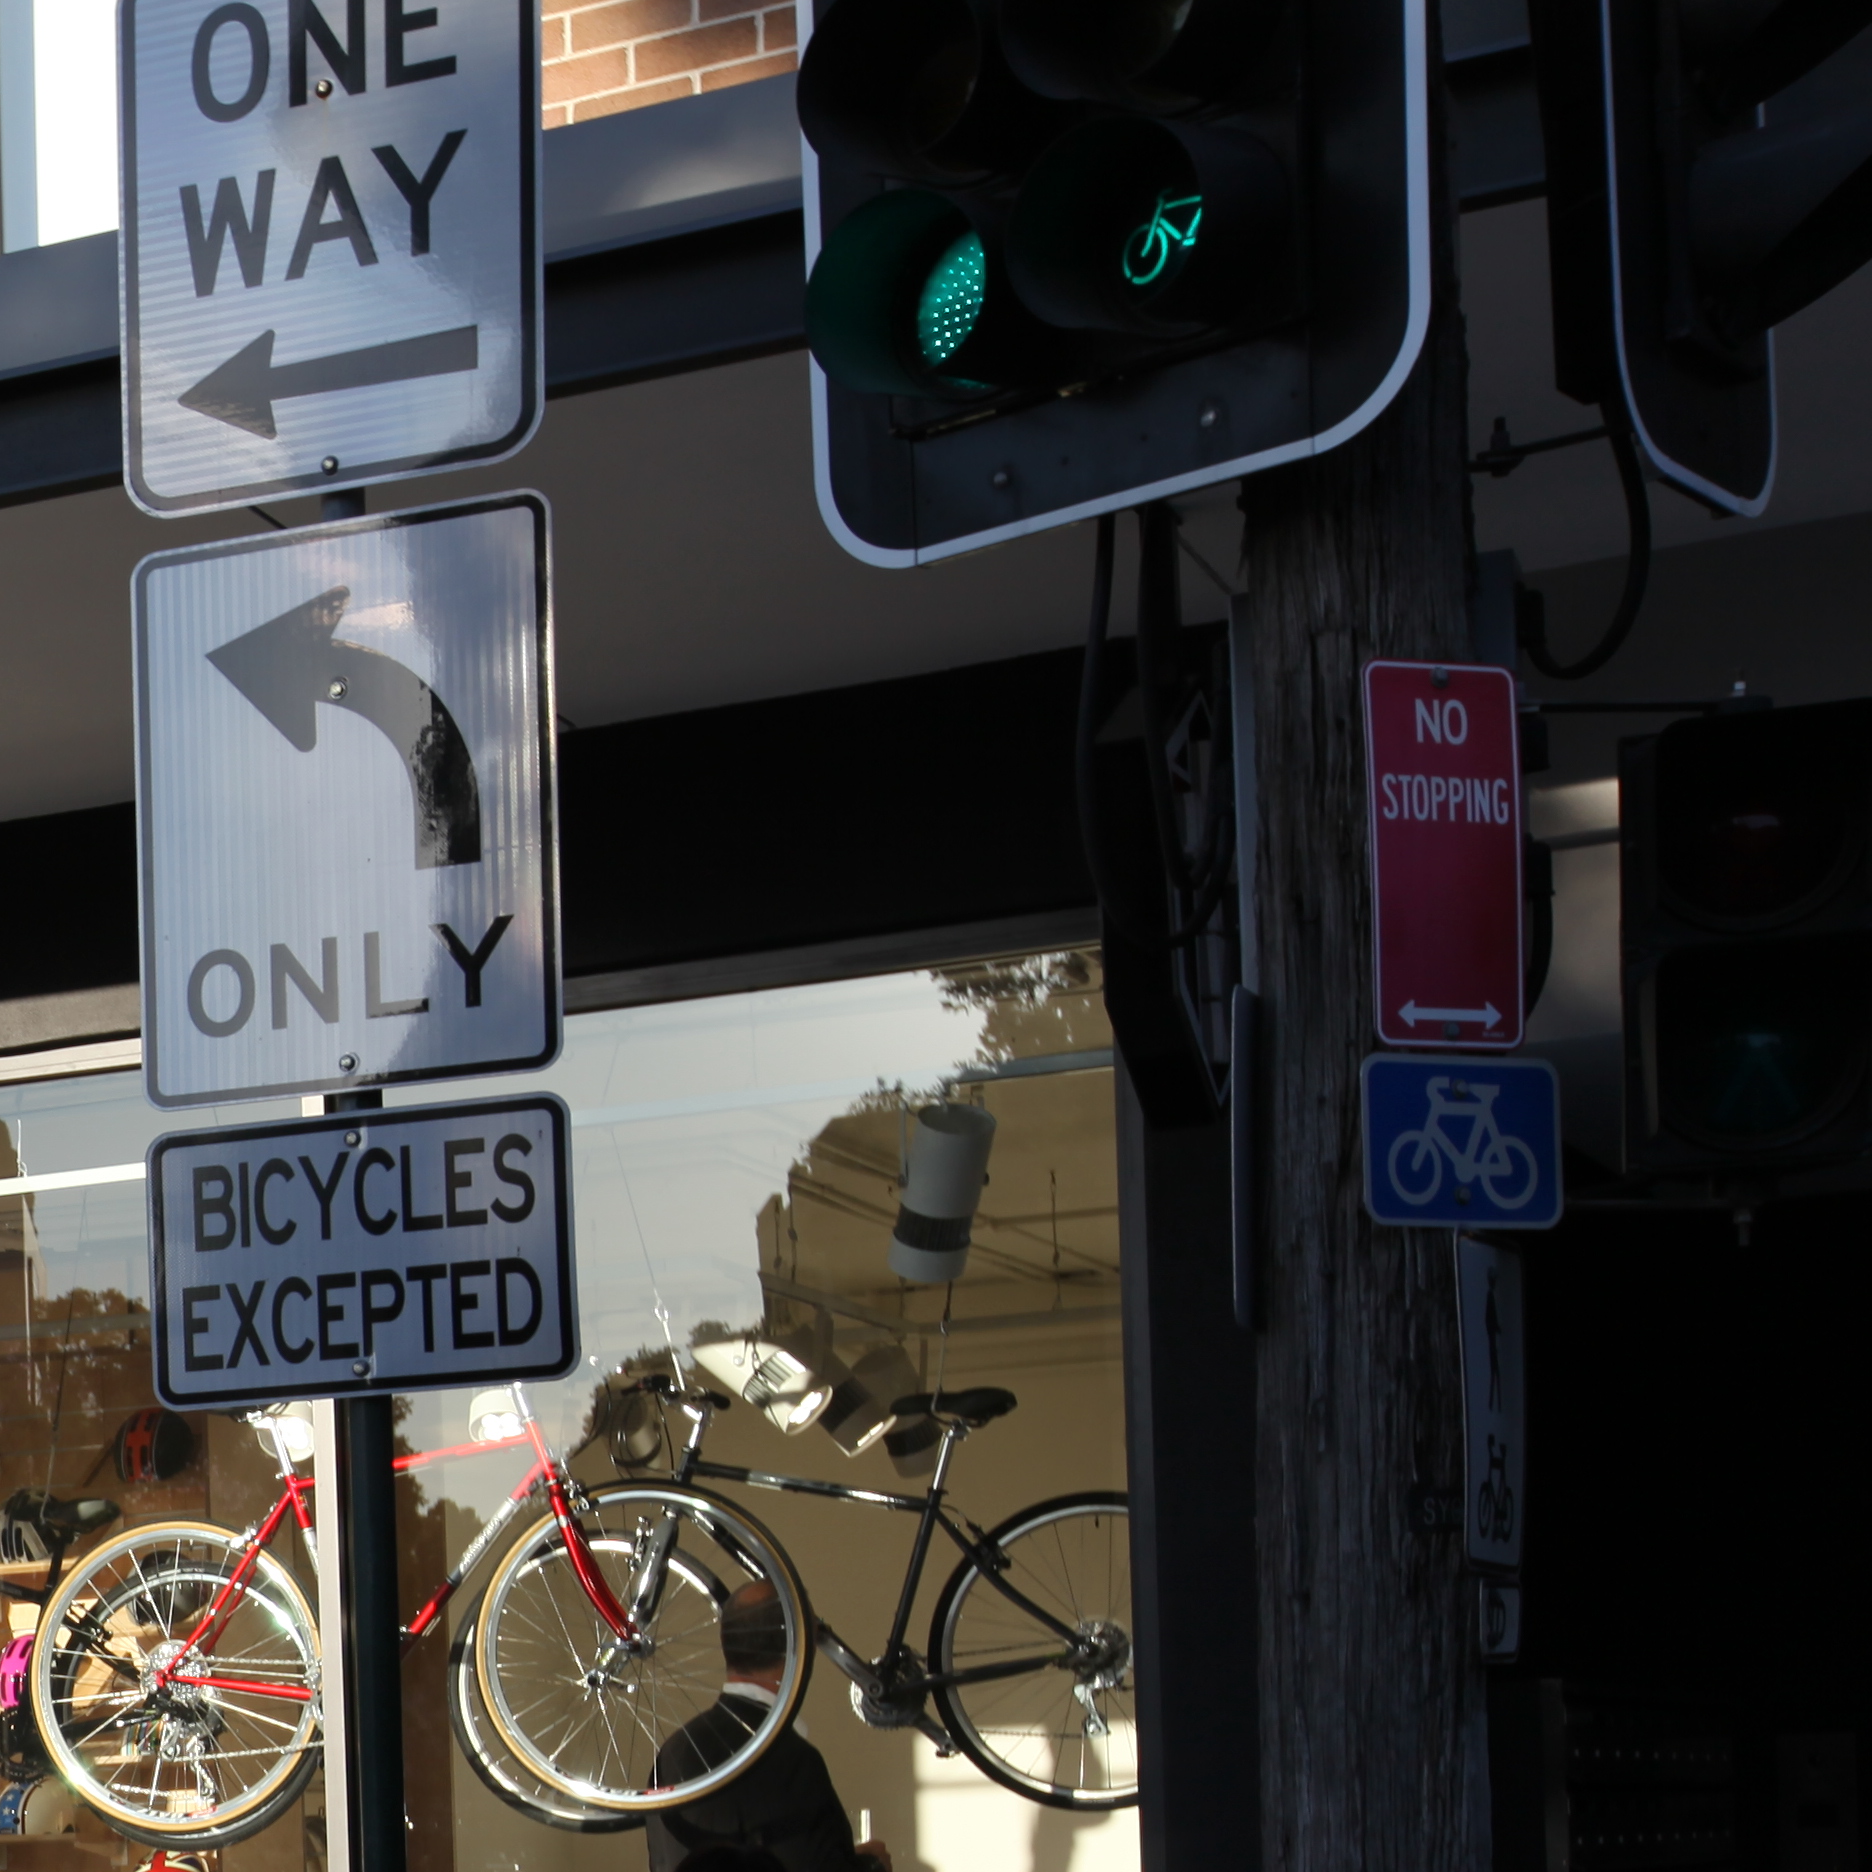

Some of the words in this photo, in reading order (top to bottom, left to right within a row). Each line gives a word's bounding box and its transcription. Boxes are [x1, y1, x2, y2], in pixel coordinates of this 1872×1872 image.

[191, 0, 457, 123] ONE
[179, 128, 468, 298] WAY
[1416, 698, 1467, 745] NO
[1382, 774, 1510, 825] STOPPING
[187, 914, 514, 1038] ONLY
[192, 1133, 536, 1252] BICYCLES
[182, 1257, 543, 1372] EXCEPTED
